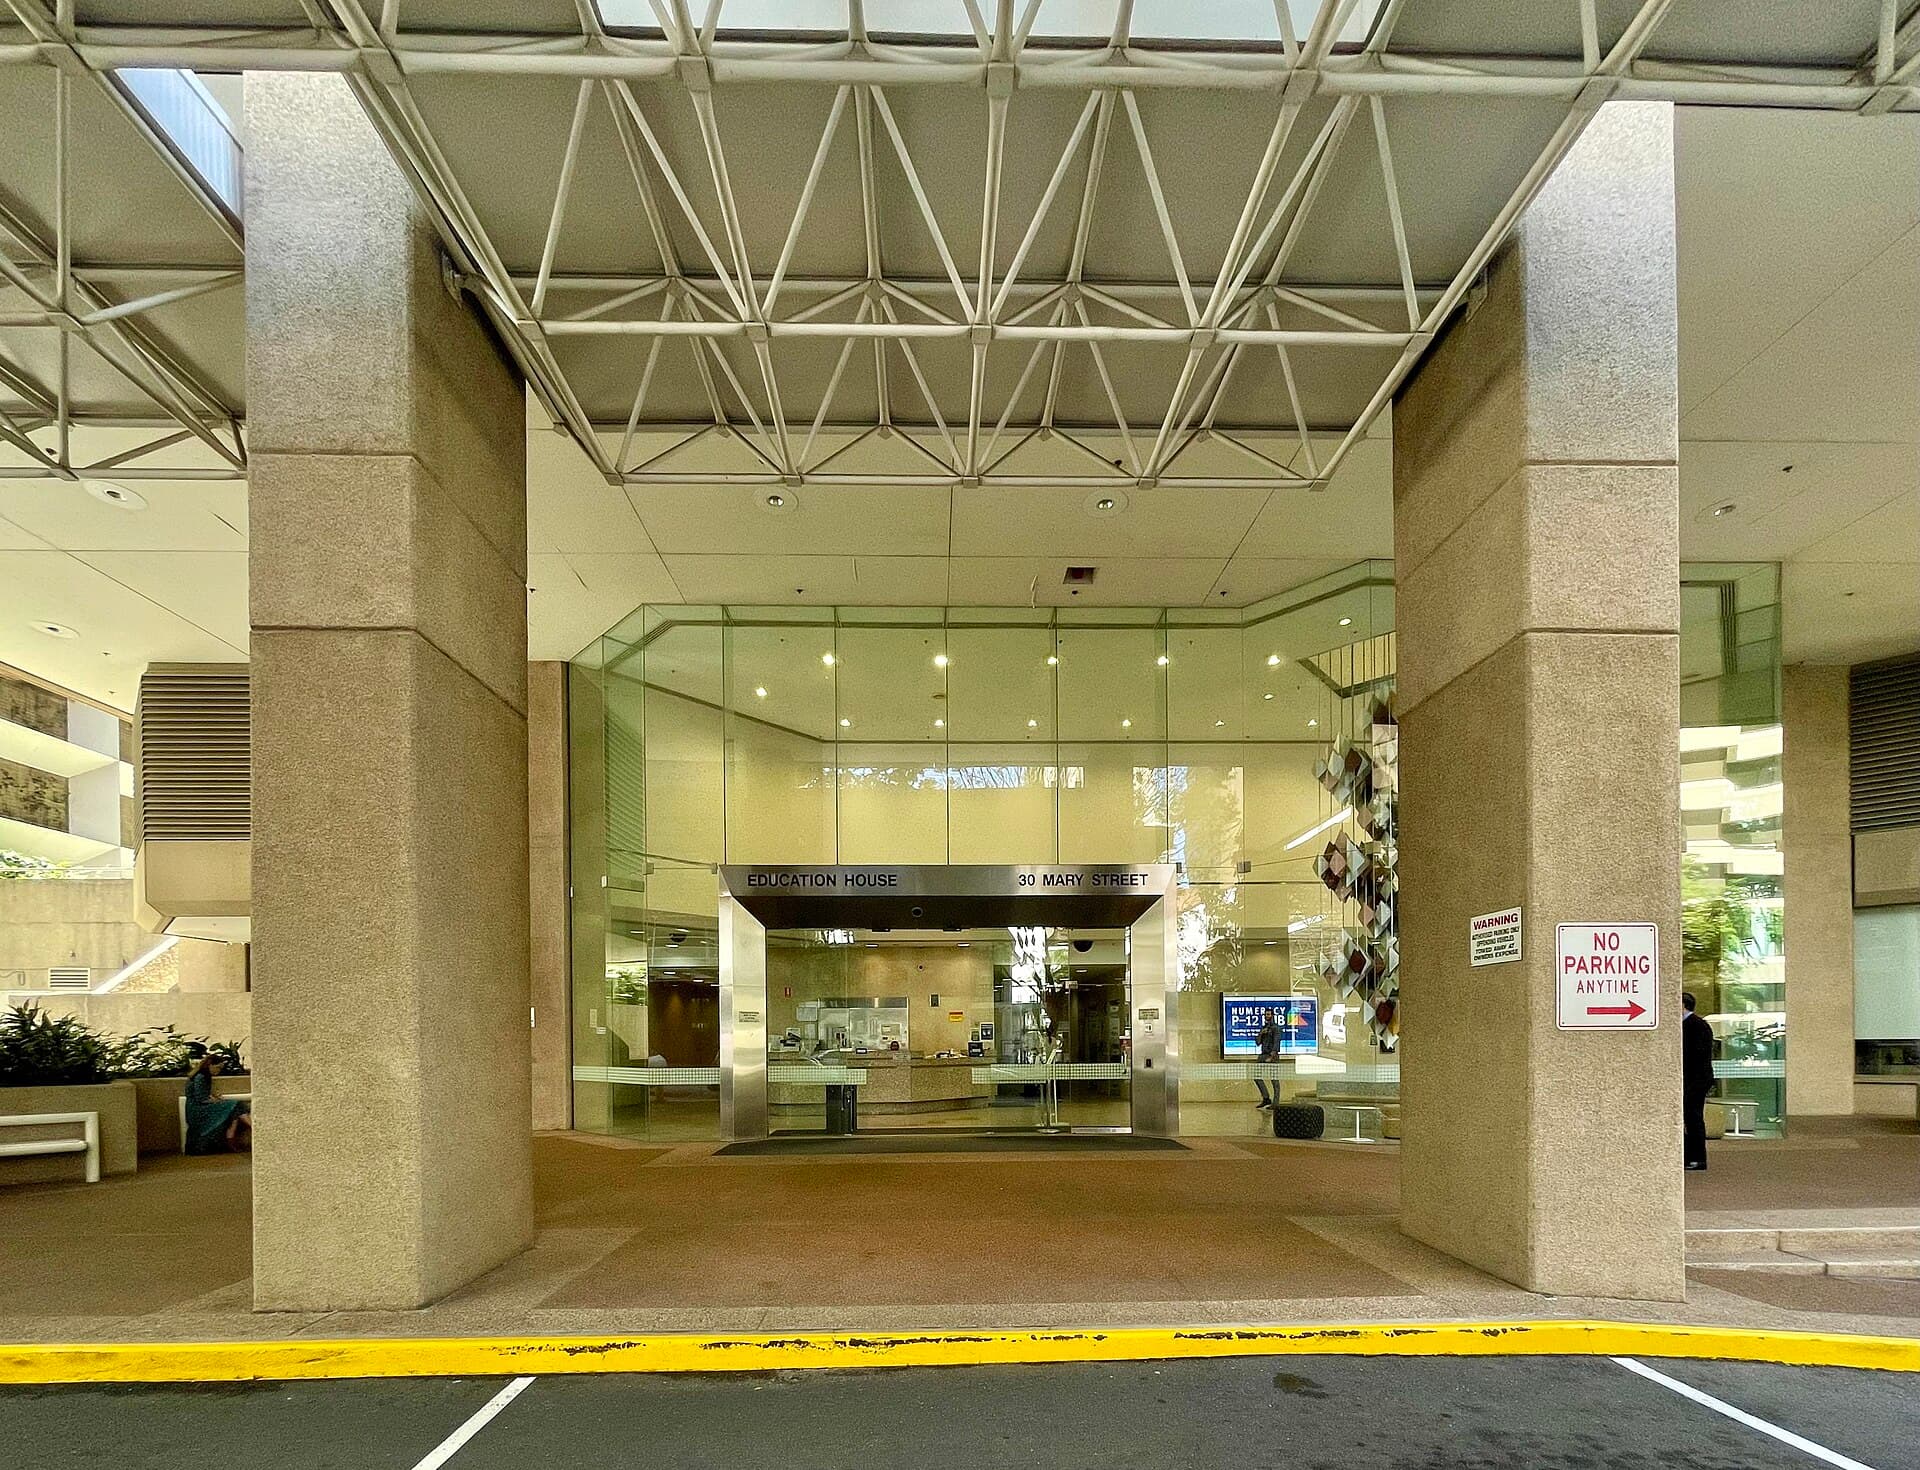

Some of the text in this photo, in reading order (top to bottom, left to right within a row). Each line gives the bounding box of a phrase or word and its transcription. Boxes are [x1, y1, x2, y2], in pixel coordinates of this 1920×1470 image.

[747, 873, 897, 887] EDUCATION HOUSE
[1018, 873, 1149, 887] 30 MARY STREET
[1473, 913, 1518, 930] WARNING
[1593, 932, 1620, 951] NO
[1564, 955, 1650, 974] PARKING
[1576, 979, 1639, 994] ANYTIME
[1231, 1006, 1286, 1016] NUMERCY
